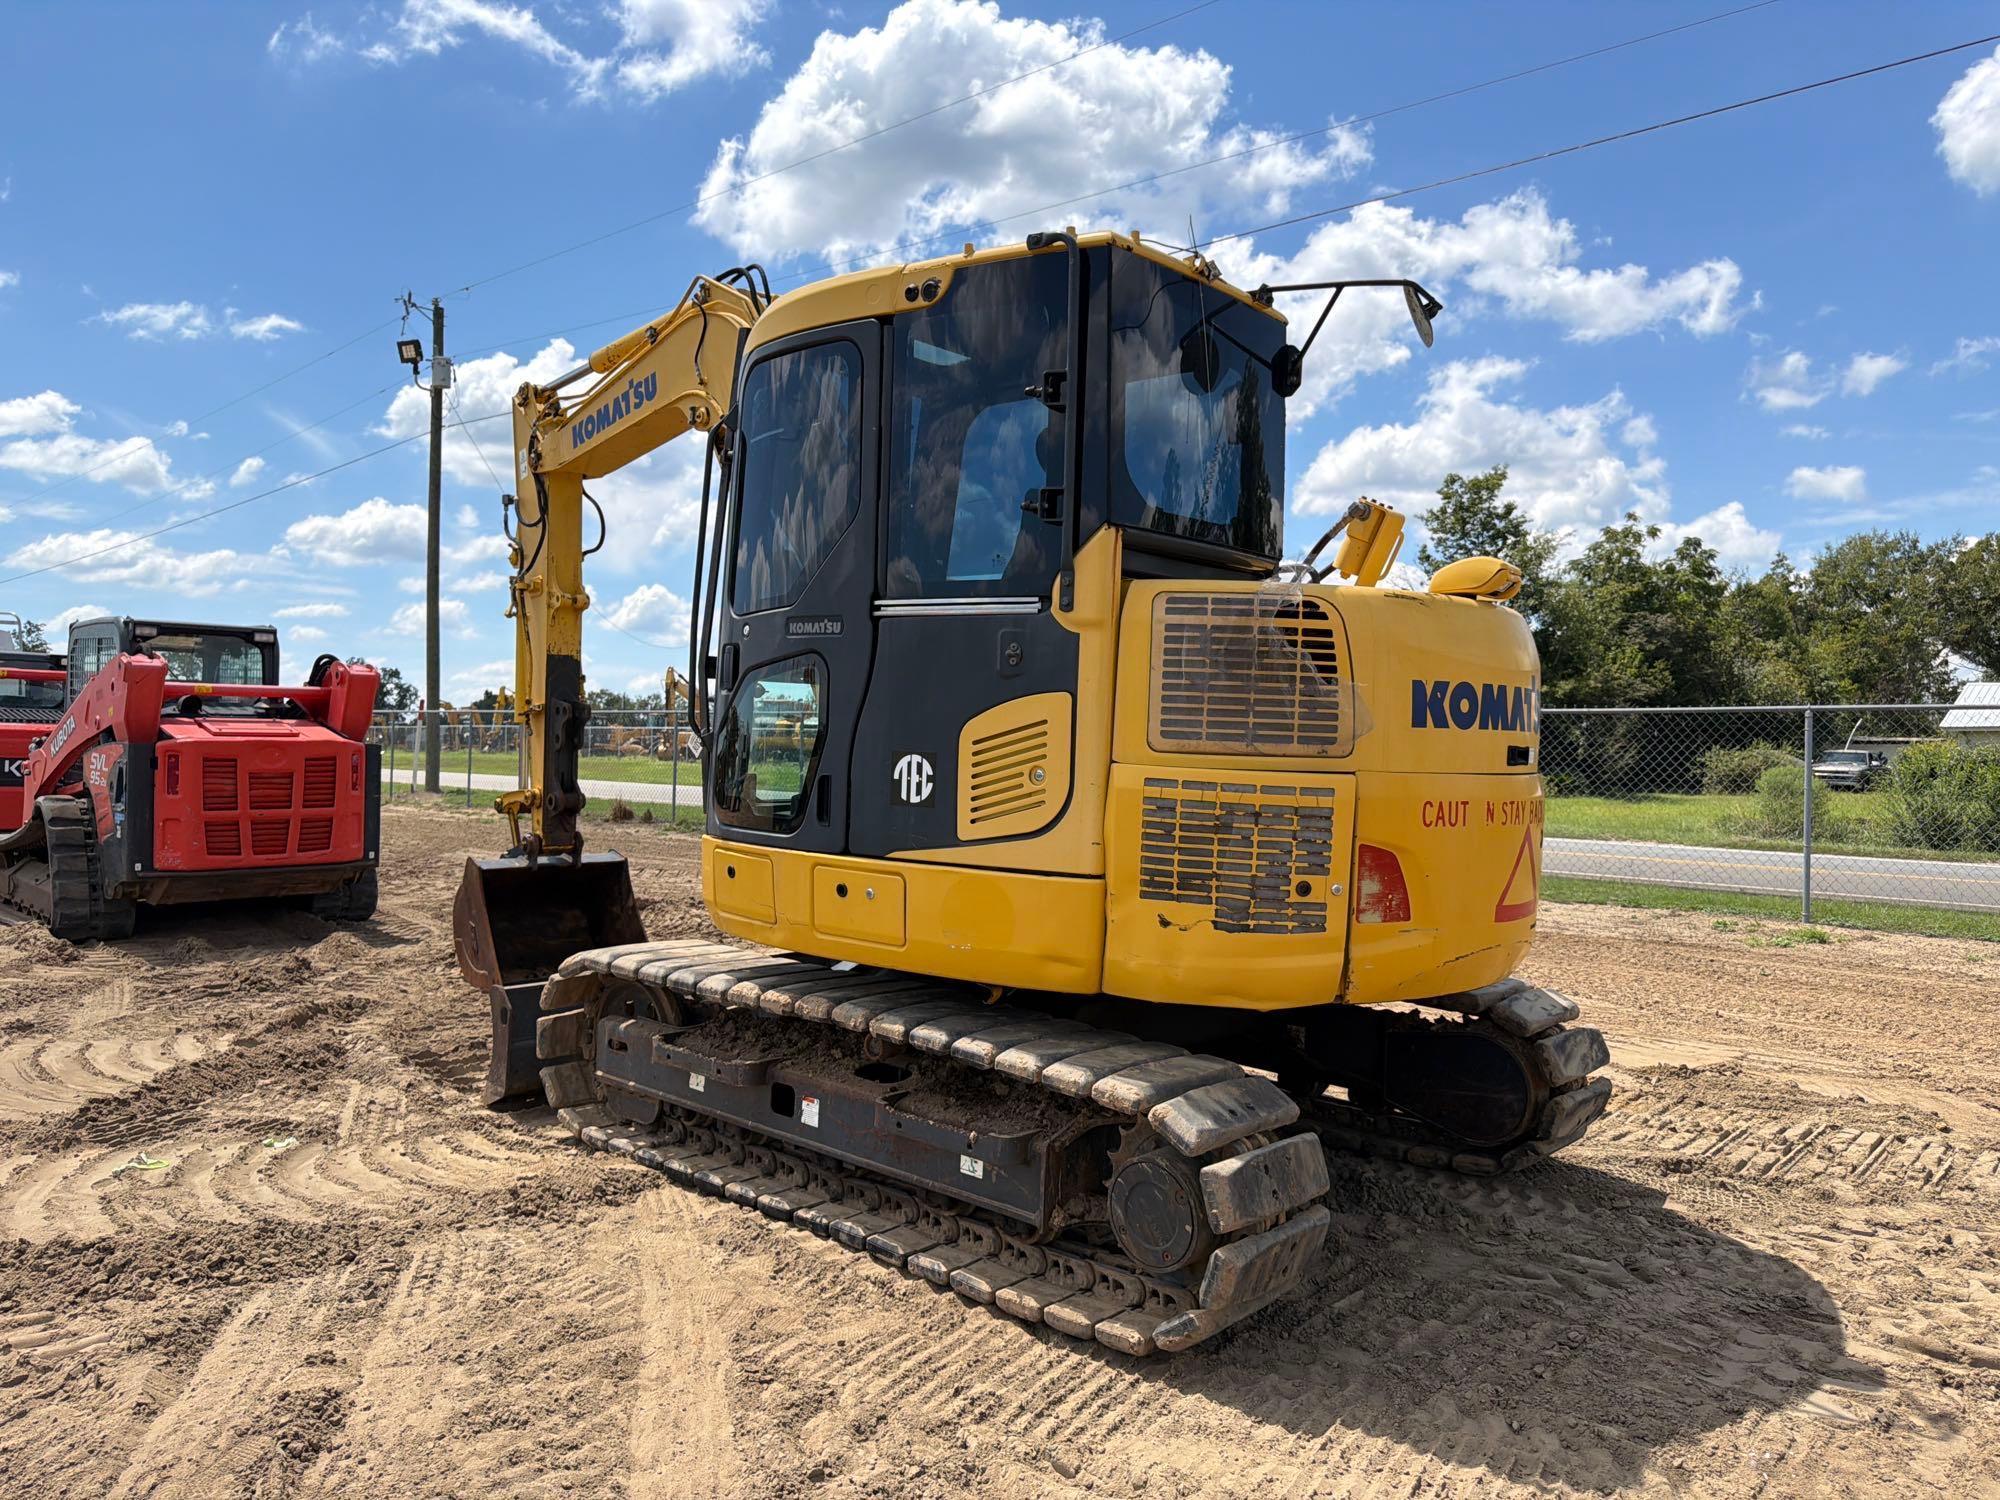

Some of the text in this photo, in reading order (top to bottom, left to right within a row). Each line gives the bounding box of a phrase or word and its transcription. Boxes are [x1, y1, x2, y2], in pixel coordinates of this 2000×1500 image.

[572, 371, 658, 449] KOMATSU
[789, 618, 841, 634] KOMATSU
[1411, 675, 1539, 735] KOMAT
[50, 715, 76, 757] KUBOTA
[90, 752, 109, 772] SVL
[1501, 800, 1526, 826] STAY
